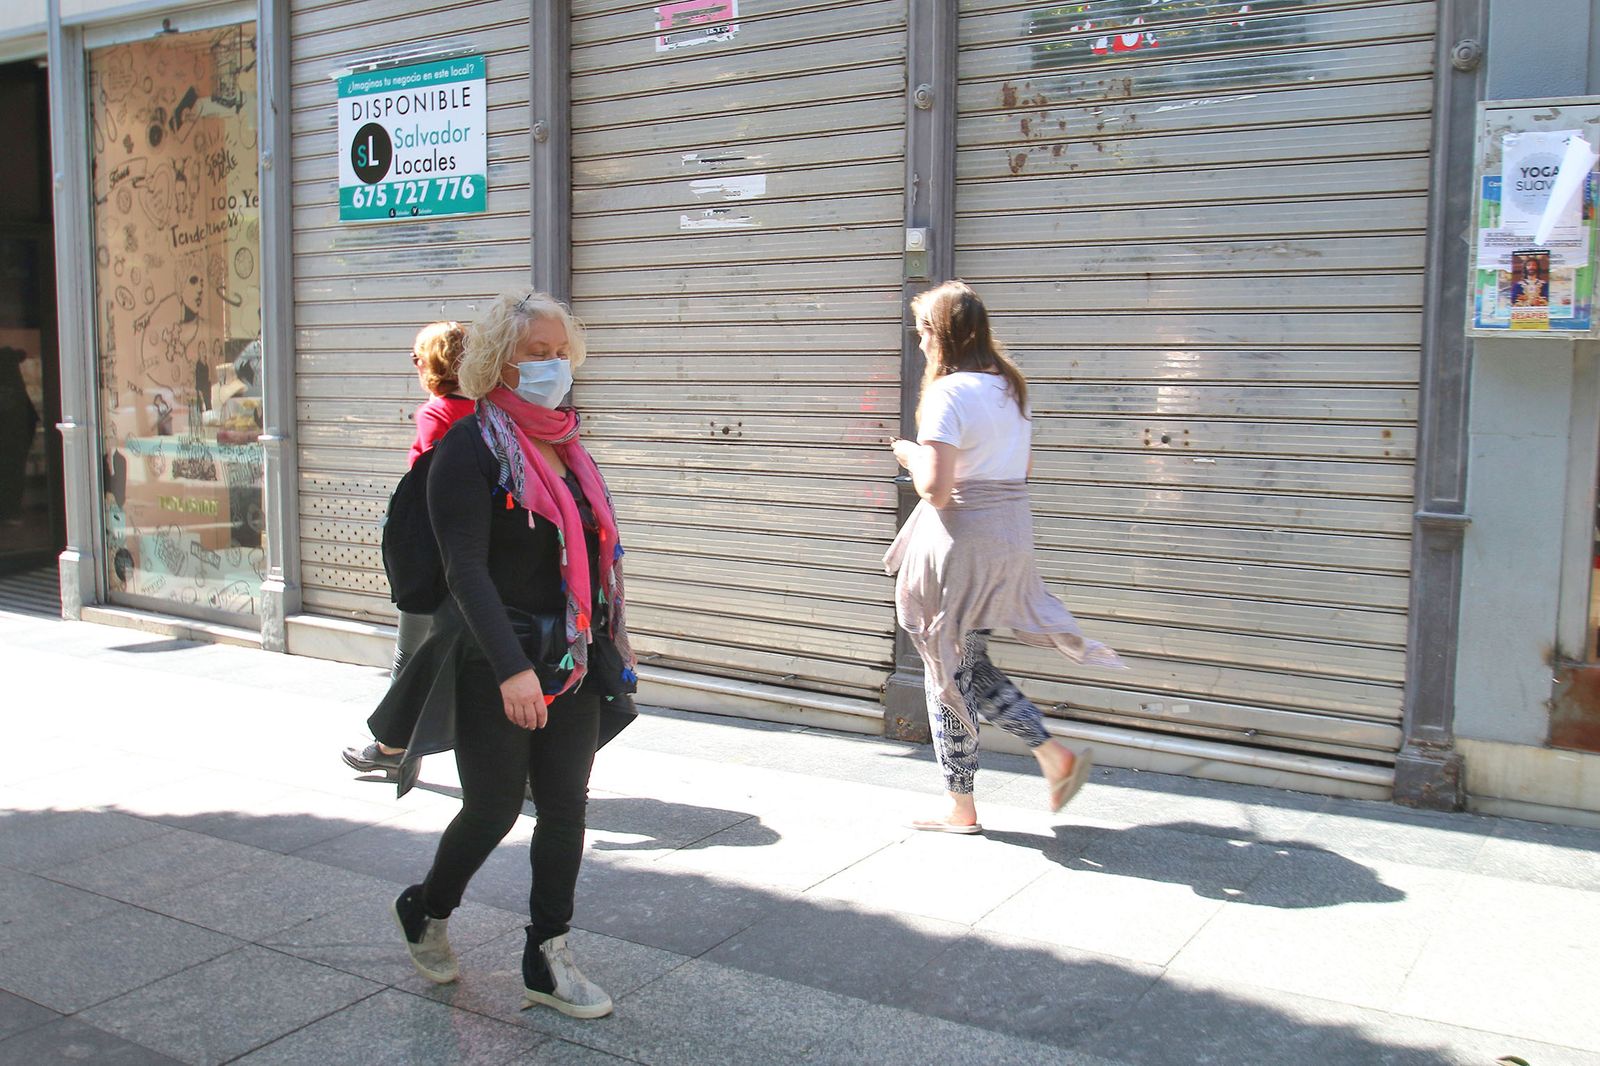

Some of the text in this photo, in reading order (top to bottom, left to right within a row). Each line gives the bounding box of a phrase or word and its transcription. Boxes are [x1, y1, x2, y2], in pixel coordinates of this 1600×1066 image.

[347, 63, 475, 94] ¿Imaginas tu negocio en este local?
[352, 87, 471, 121] DISPONIBLE
[394, 120, 471, 149] Salvador
[395, 148, 456, 175] Locales
[353, 176, 475, 209] 675 727 776
